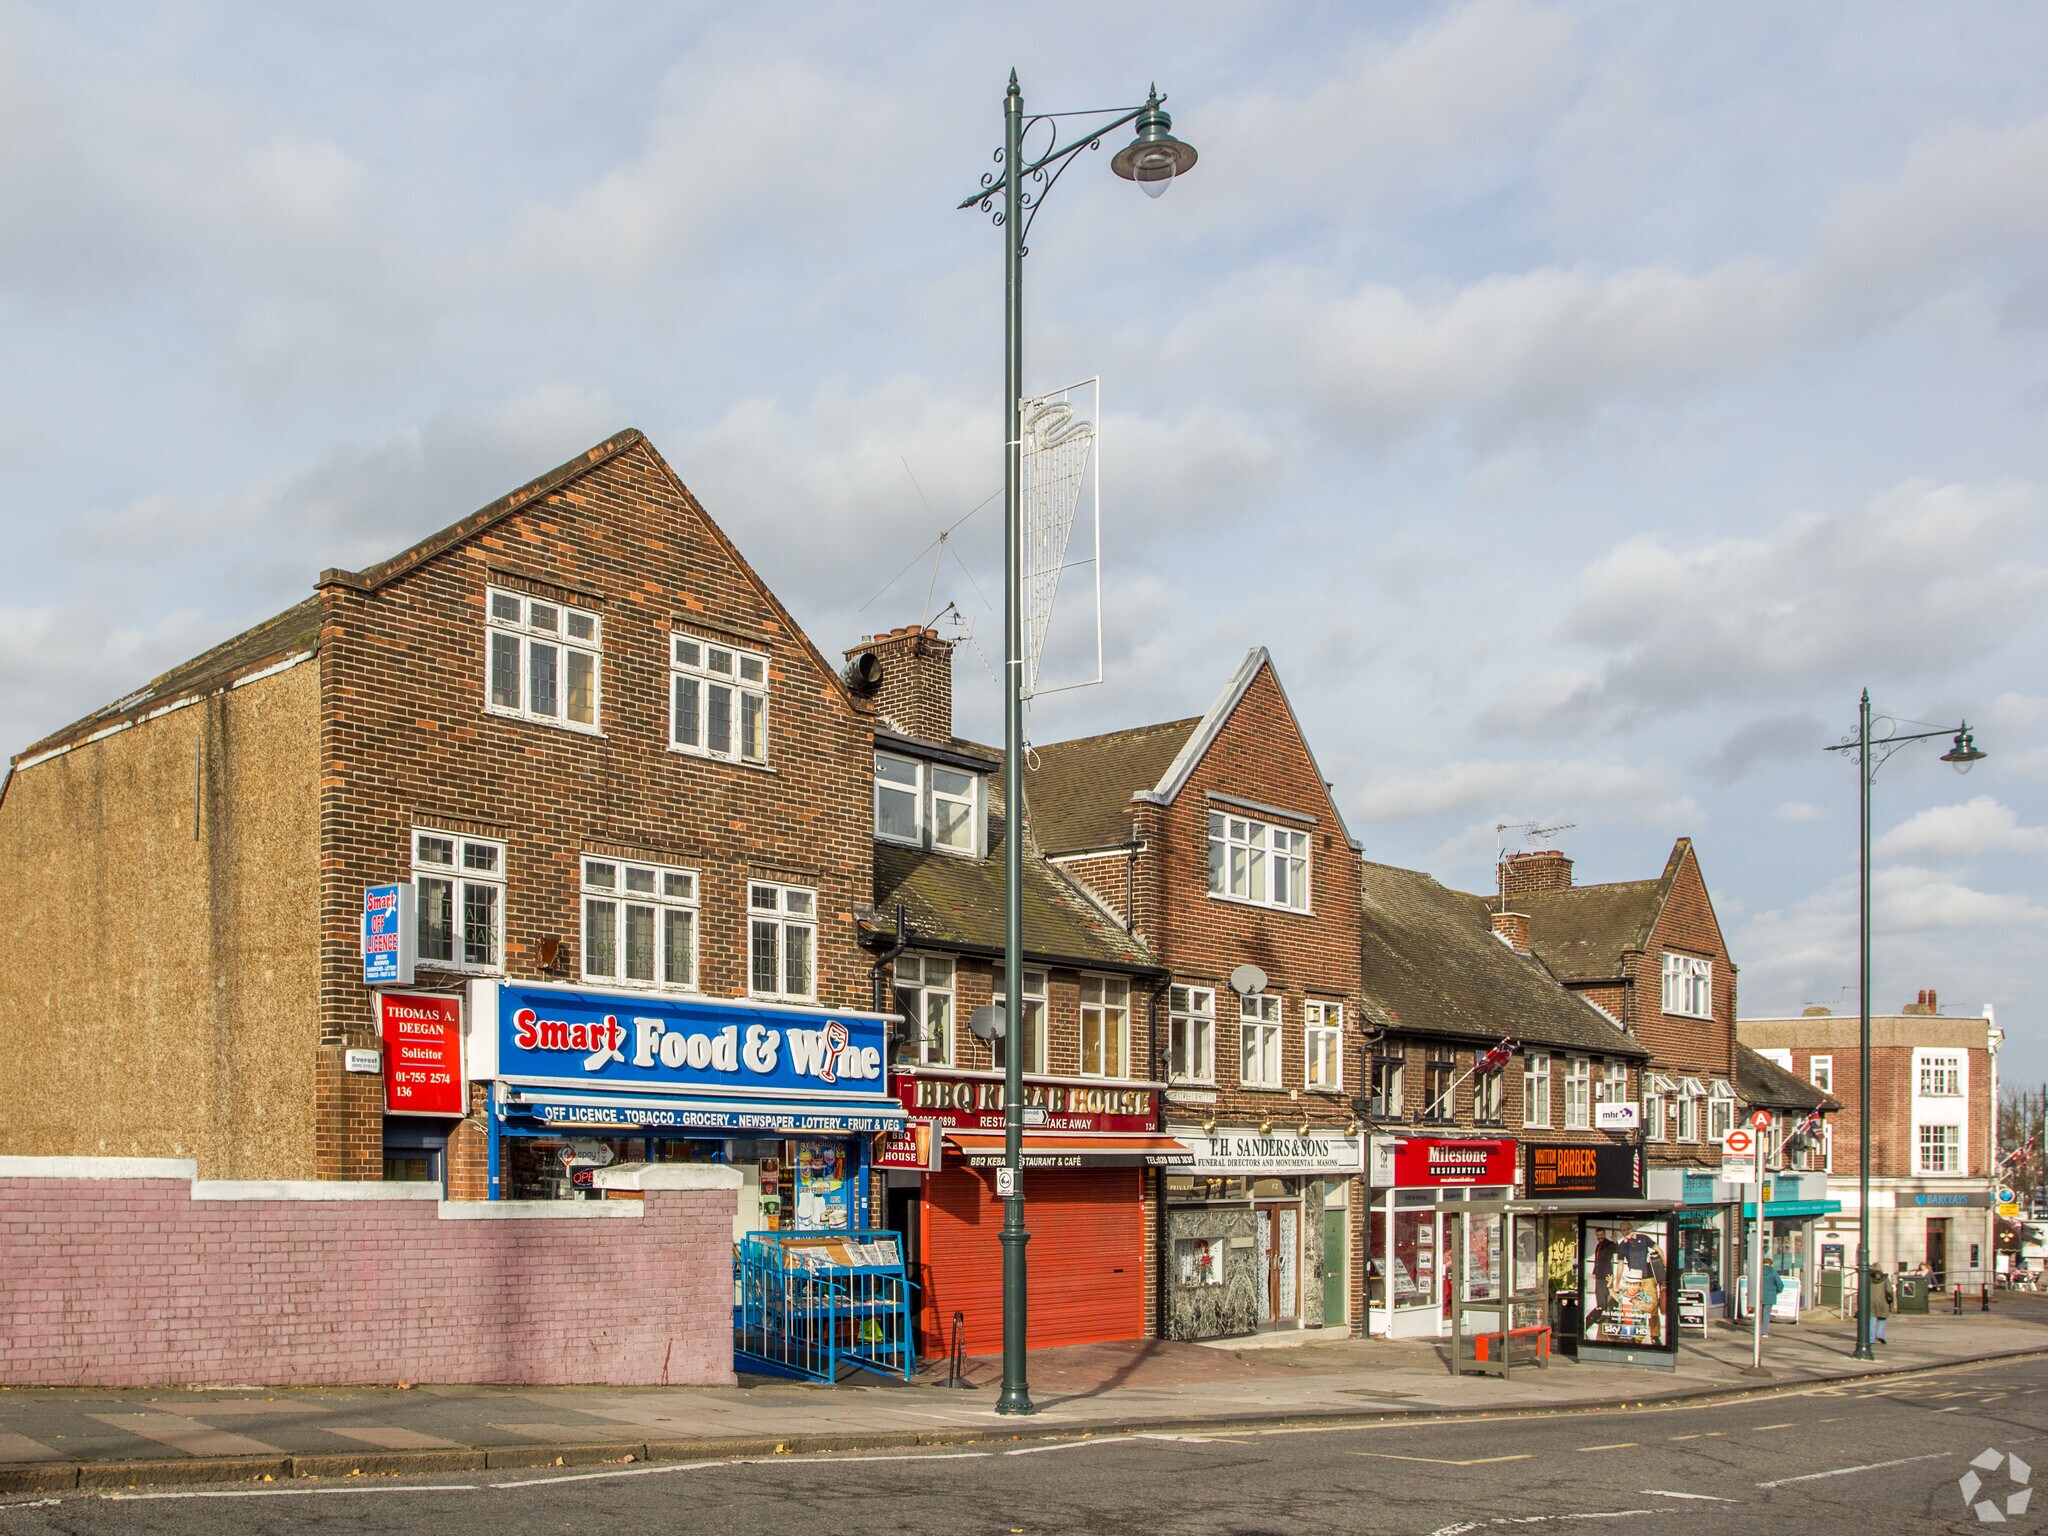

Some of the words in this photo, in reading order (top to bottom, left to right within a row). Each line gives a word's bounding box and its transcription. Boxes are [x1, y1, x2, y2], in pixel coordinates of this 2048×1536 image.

[367, 890, 396, 912] Smart
[371, 915, 385, 934] OFF
[366, 933, 397, 953] LICENCE
[387, 1007, 439, 1020] THOMAS
[444, 1011, 455, 1021] A.
[399, 1022, 444, 1035] DEEGAN
[514, 1008, 622, 1054] Smart
[632, 1017, 738, 1073] Food
[742, 1023, 781, 1074] &
[786, 1020, 881, 1083] Wine
[401, 1047, 442, 1059] Solicitor
[352, 1056, 377, 1064] Everest
[395, 1071, 426, 1083] 01-755
[430, 1073, 450, 1084] 2574
[396, 1086, 412, 1097] 136
[915, 1081, 975, 1114] BBQ
[1069, 1088, 1150, 1115] HOUSE
[545, 1106, 566, 1120] OFF
[568, 1107, 618, 1122] LICENCE
[625, 1110, 675, 1124] TOBACCO
[683, 1112, 730, 1126] GROCERY
[738, 1114, 794, 1128] NEWSPAPER
[801, 1117, 842, 1129] LOTTERY
[848, 1119, 872, 1130] FRUIT
[874, 1119, 881, 1130] &
[882, 1120, 900, 1131] VEG
[1069, 1119, 1092, 1130] AWAY
[1755, 1113, 1768, 1125] A
[1145, 1122, 1155, 1131] 134
[892, 1131, 911, 1143] BBQ
[886, 1142, 916, 1151] KEBAB
[1209, 1138, 1231, 1157] T.H.
[1237, 1139, 1290, 1157] SANDERS
[1301, 1140, 1329, 1157] SONS
[577, 1151, 597, 1161] epay
[885, 1152, 917, 1162] HOUSE
[970, 1157, 985, 1166] BBQ
[1057, 1157, 1063, 1165] &
[1064, 1155, 1082, 1166] CAFÉ
[1428, 1146, 1488, 1163] Milestone
[1535, 1149, 1556, 1164] WHITTON
[1198, 1158, 1226, 1167] FUNERAL
[1227, 1159, 1260, 1167] DIRECTORS
[1262, 1159, 1274, 1167] AND
[1275, 1159, 1315, 1167] MONUMENTAL
[1317, 1159, 1338, 1167] MASONS
[1557, 1149, 1597, 1177] BARBERS
[1430, 1167, 1486, 1175] RESIDENTIAL
[573, 1171, 594, 1184] OPE
[1535, 1170, 1556, 1185] STATION
[1926, 1195, 1968, 1204] BARCLAYS
[1604, 1324, 1620, 1336] sky
[1635, 1327, 1648, 1335] HD
